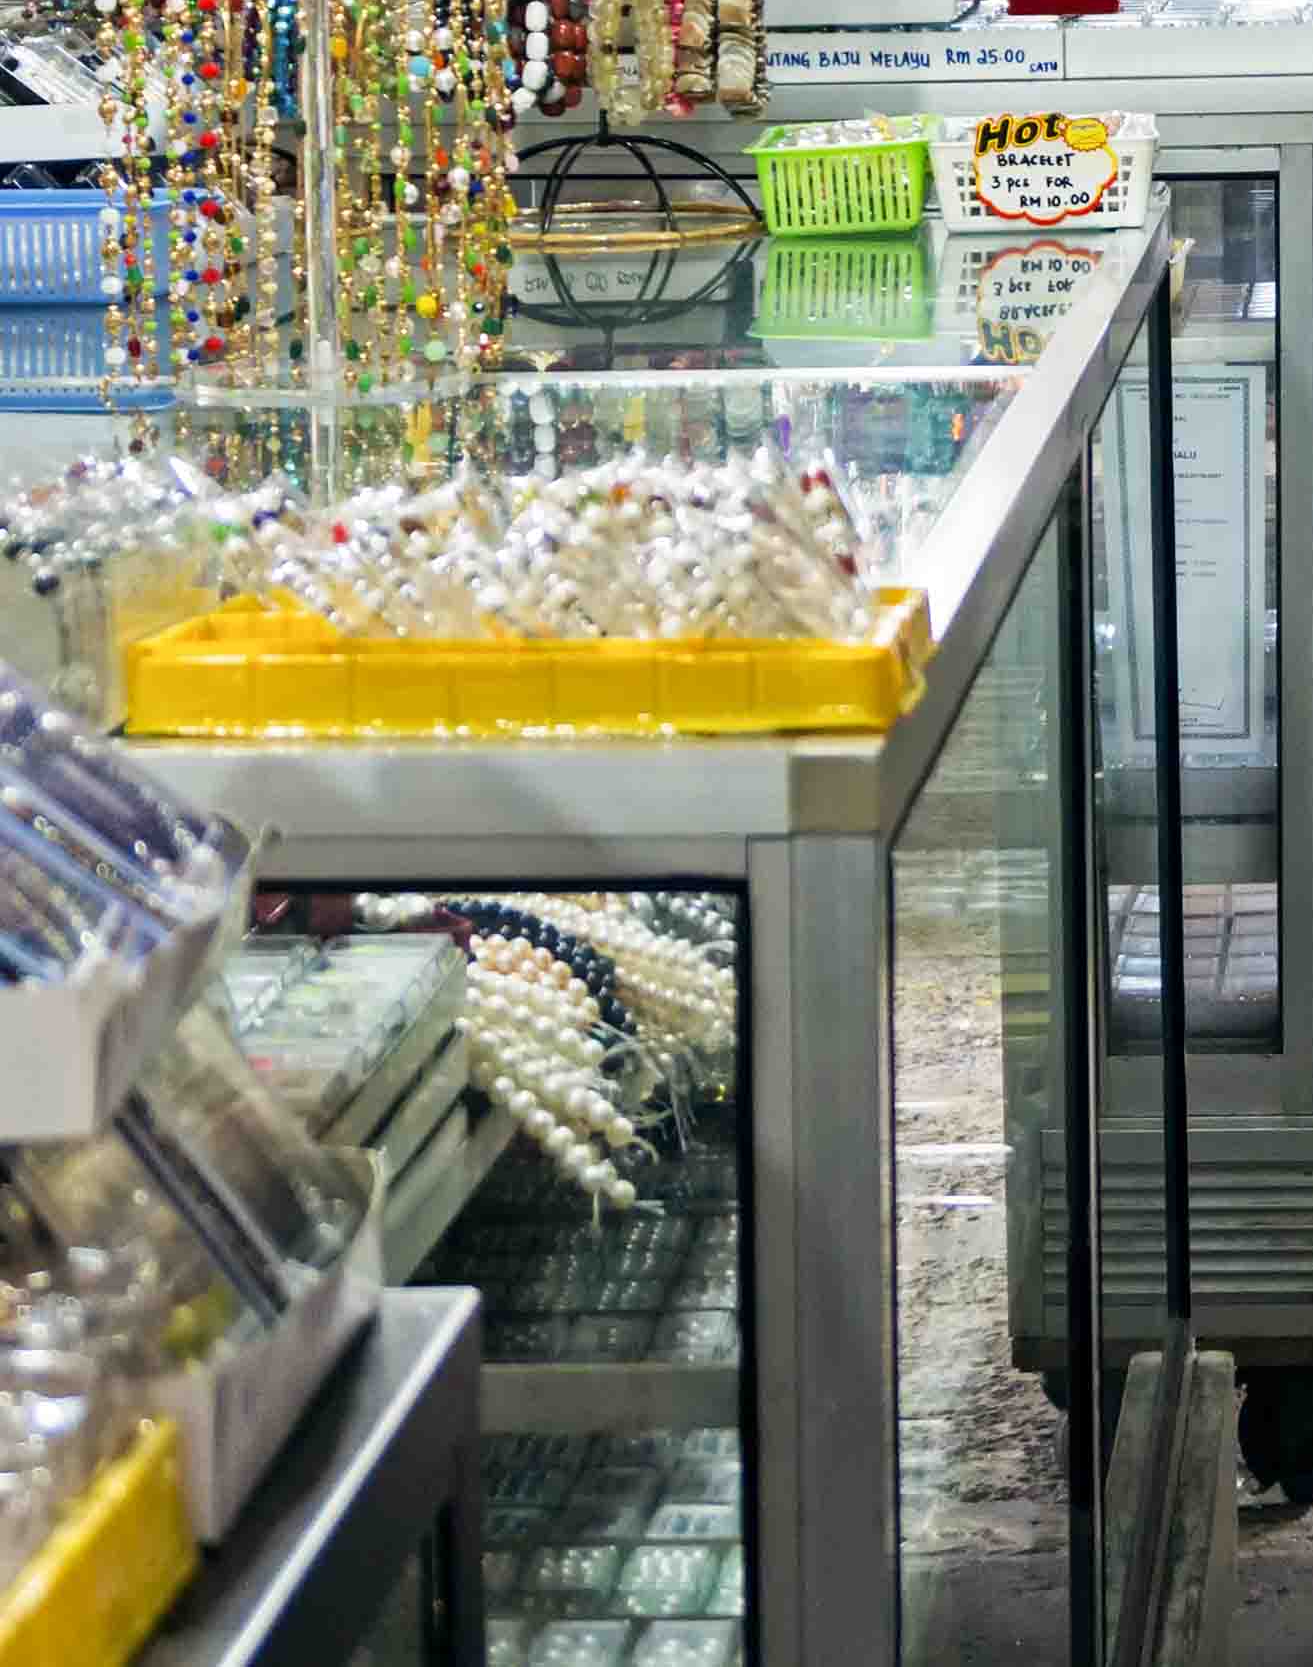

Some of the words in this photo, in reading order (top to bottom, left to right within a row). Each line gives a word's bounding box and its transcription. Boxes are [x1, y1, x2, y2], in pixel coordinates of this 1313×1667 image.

[767, 51, 810, 68] UTANG
[819, 51, 861, 67] BAJU
[871, 50, 930, 69] MELAYU
[976, 48, 1025, 64] 25.00
[992, 175, 1001, 189] 3
[1046, 176, 1073, 188] FOR
[1020, 195, 1041, 208] RM
[1047, 192, 1090, 207] 10.00
